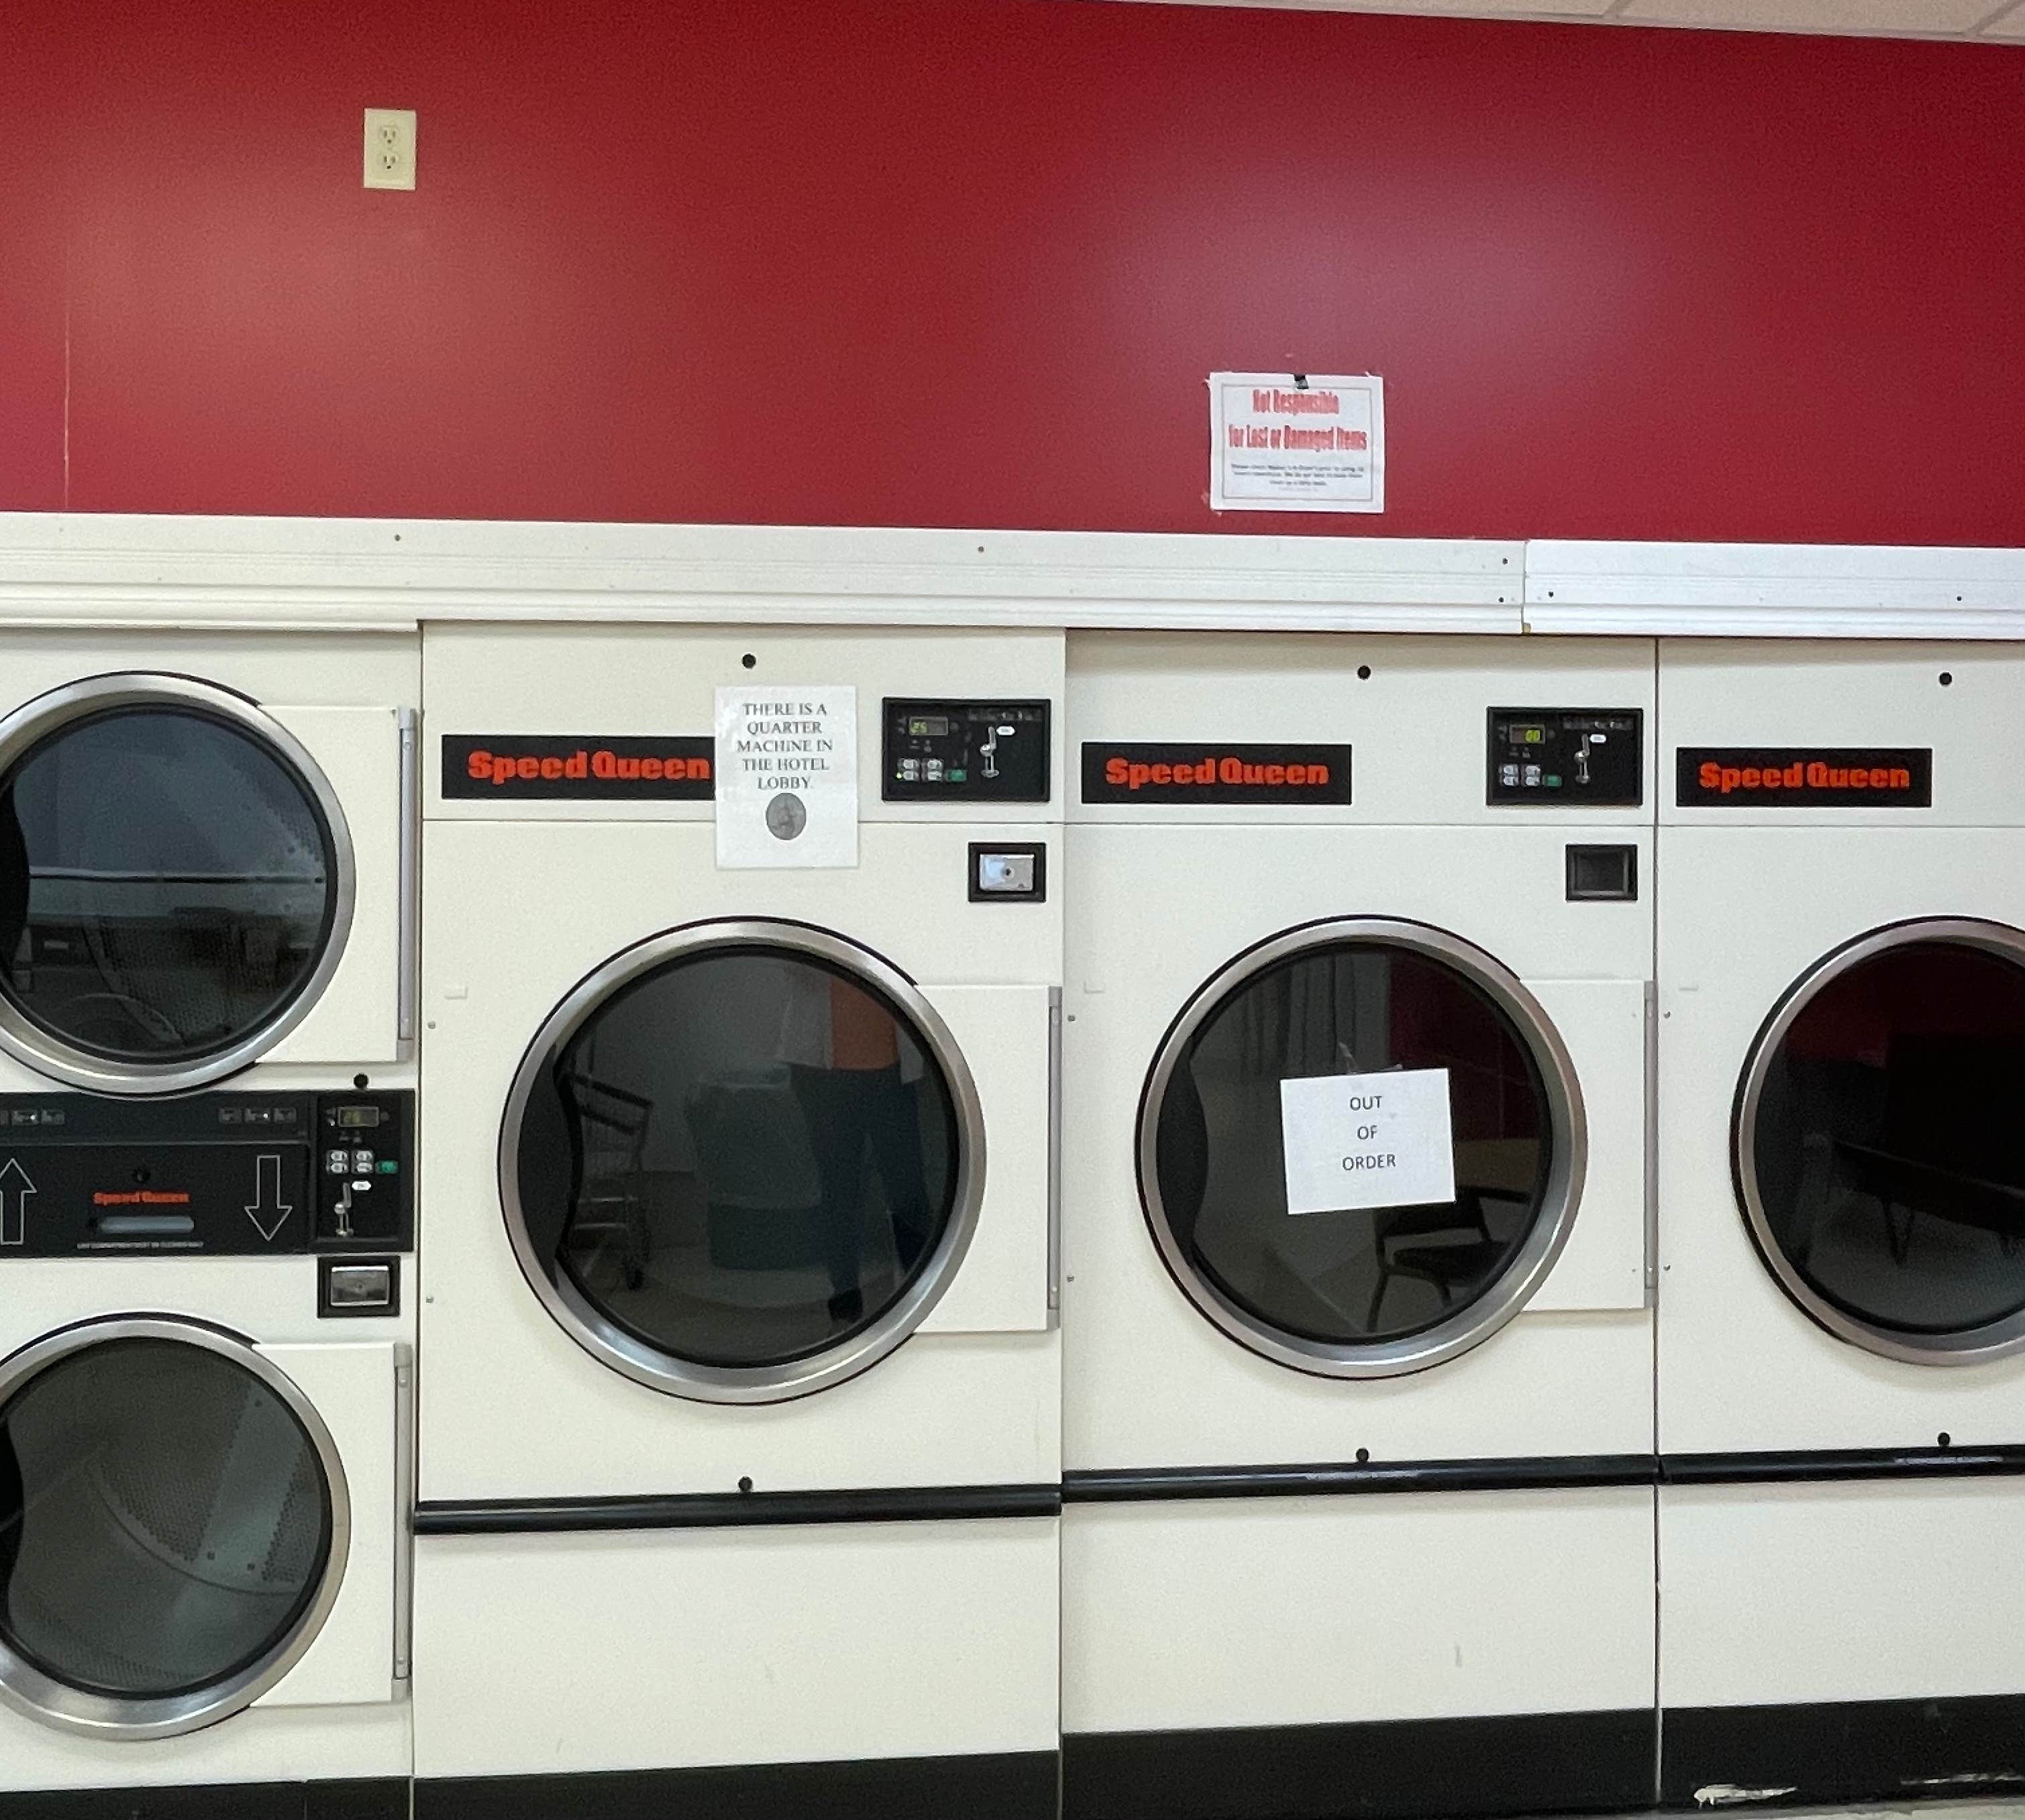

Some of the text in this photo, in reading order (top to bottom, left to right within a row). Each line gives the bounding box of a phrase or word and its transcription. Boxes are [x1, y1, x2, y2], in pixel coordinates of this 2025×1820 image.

[1253, 389, 1339, 415] Not Responsible
[1229, 424, 1367, 452] for Lost or Damaged Items
[743, 703, 827, 716] THERE IS A
[747, 721, 823, 735] QUARTER
[737, 739, 833, 752] MACHINE IN
[468, 751, 710, 784] Speed Queen
[742, 758, 830, 771] THE HOTEL
[1105, 757, 1329, 790] Speed Queen
[1700, 762, 1910, 794] Speed Queen
[1350, 1095, 1382, 1111] OUT
[1357, 1125, 1378, 1140] OF
[1342, 1153, 1396, 1171] ORDER
[94, 1191, 189, 1206] Speed Queen
